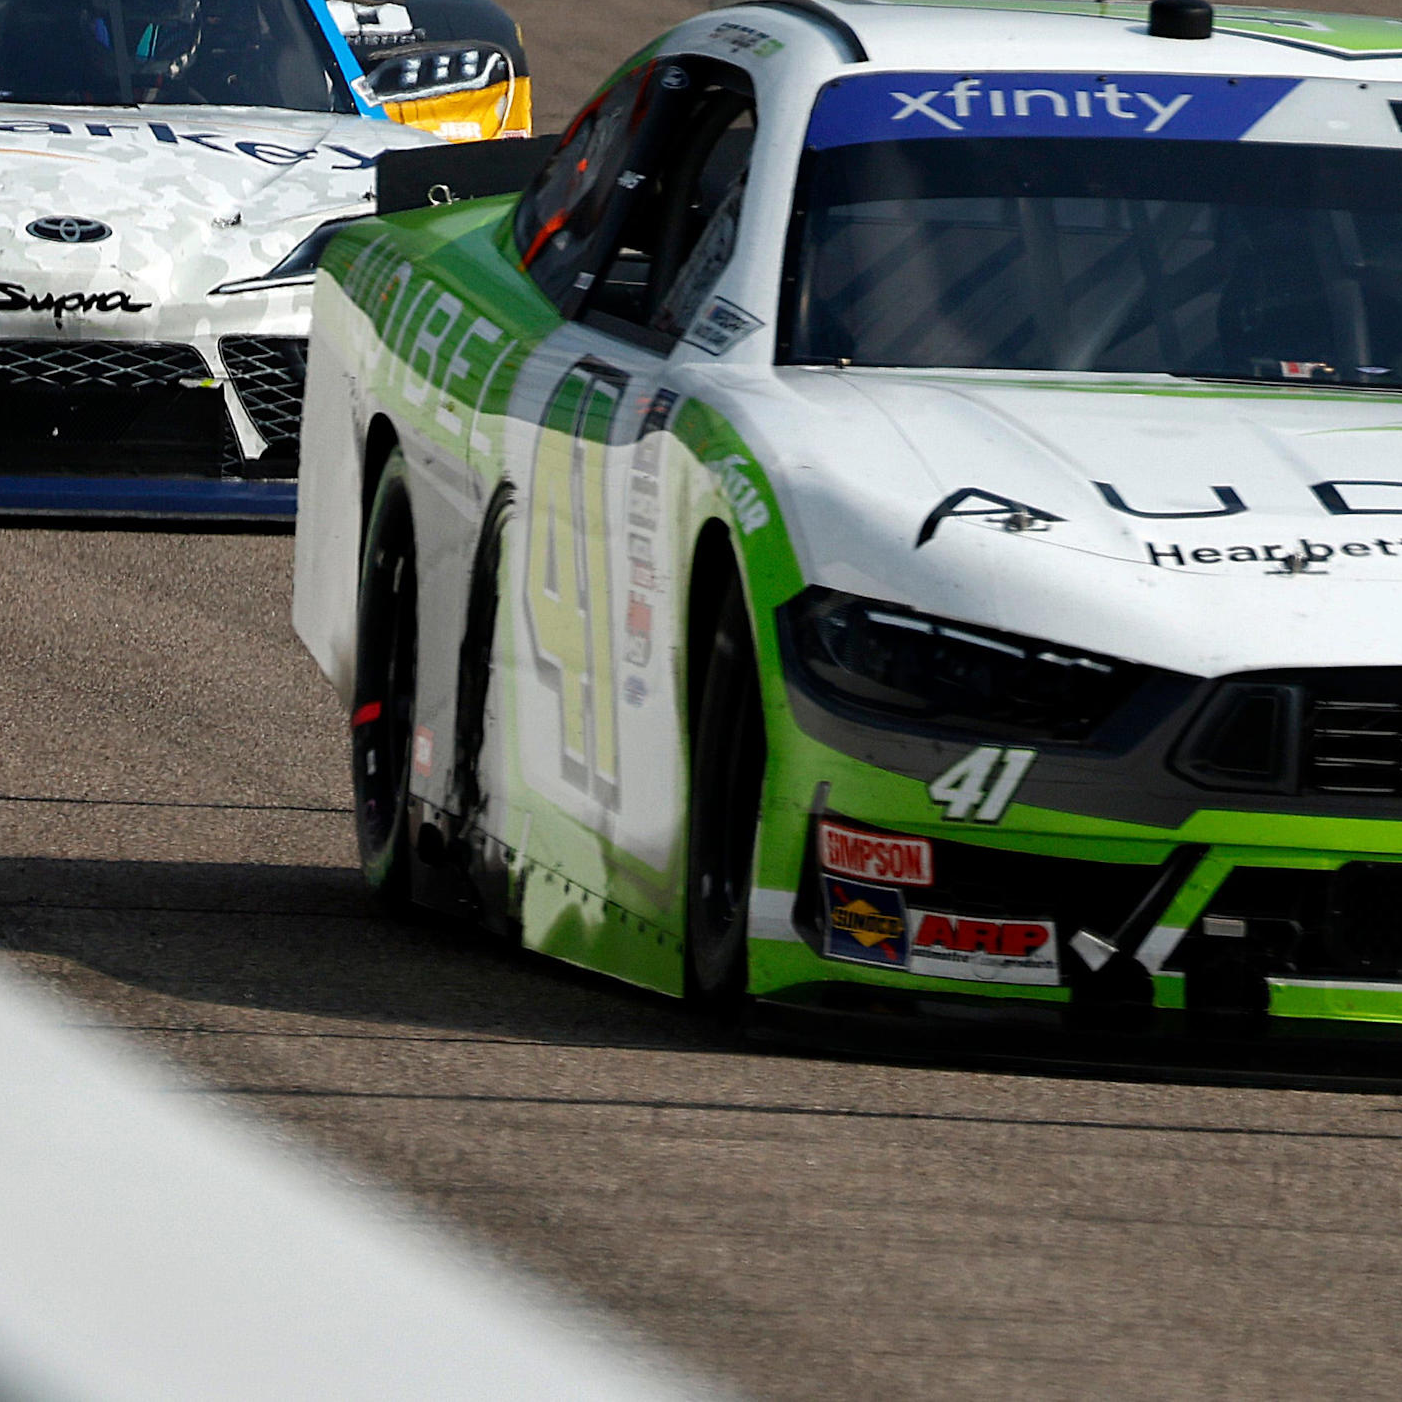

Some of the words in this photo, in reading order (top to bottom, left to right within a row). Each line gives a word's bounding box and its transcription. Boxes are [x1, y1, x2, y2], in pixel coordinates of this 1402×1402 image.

[889, 79, 1194, 132] xfinity
[1147, 540, 1278, 568] Hear
[927, 743, 1038, 824] 41
[827, 829, 923, 880] SIMPSON
[913, 914, 1050, 957] ARP
